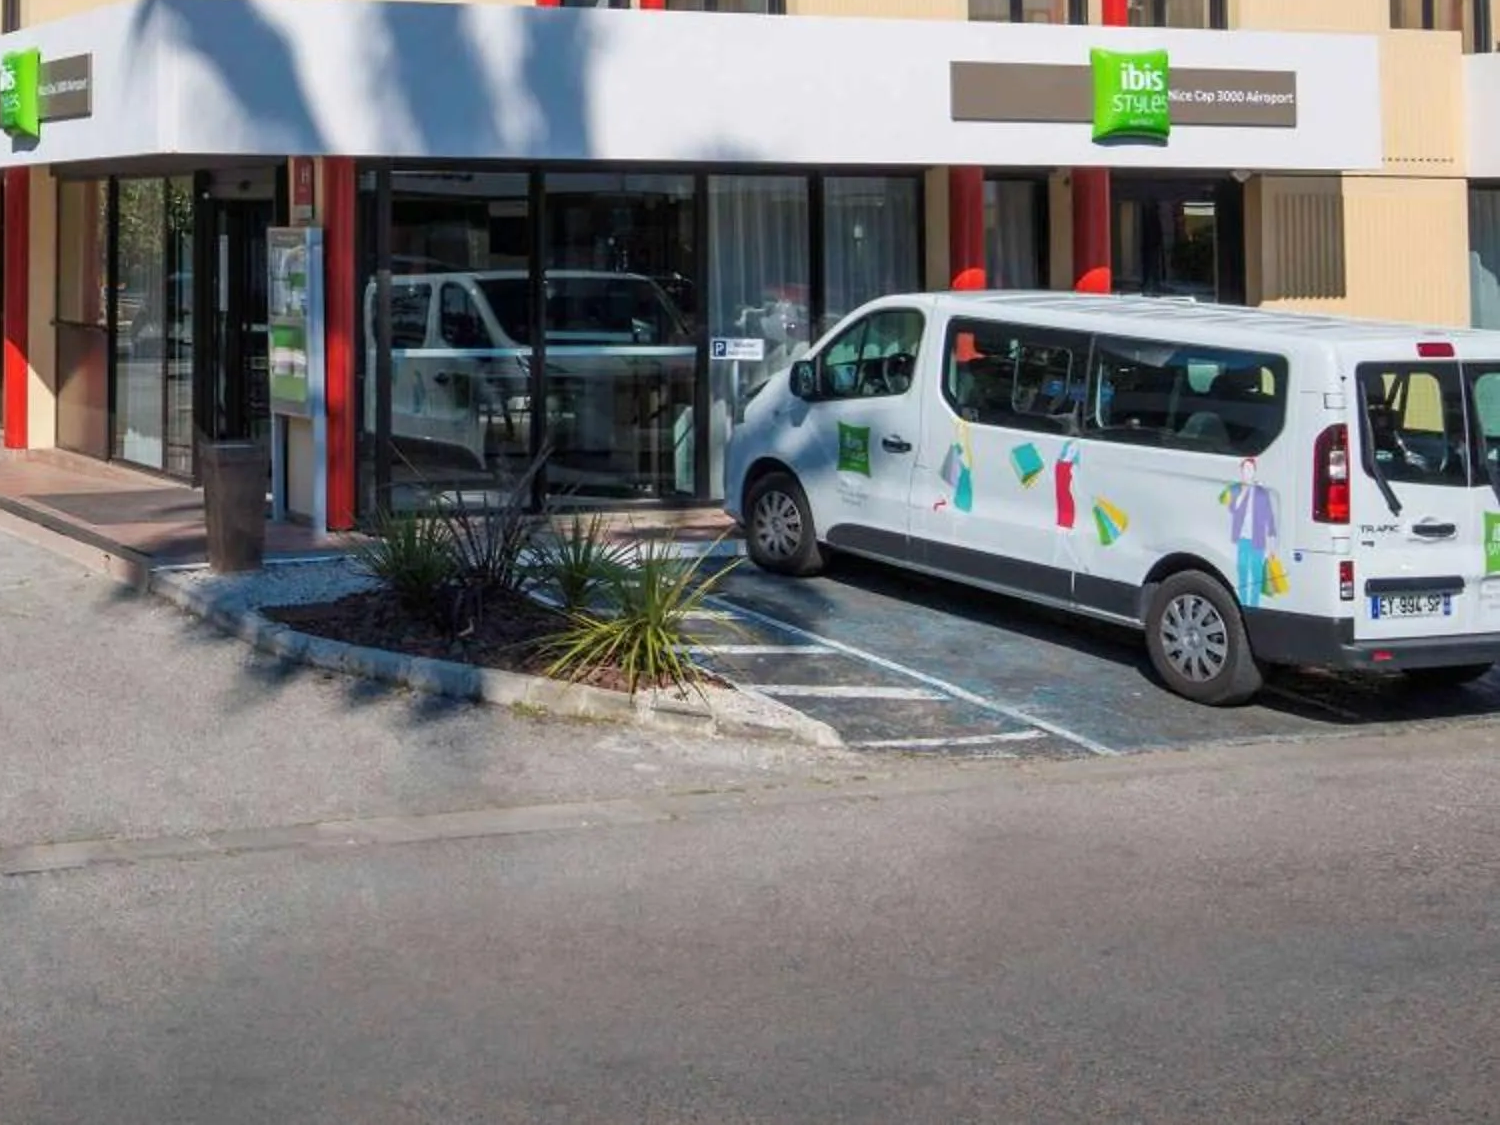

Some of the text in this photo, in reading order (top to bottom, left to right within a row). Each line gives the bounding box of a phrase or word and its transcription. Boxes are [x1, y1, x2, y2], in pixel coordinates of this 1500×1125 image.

[1120, 62, 1164, 91] ibis
[1168, 90, 1294, 105] Nice Cap 3000 Aéroport
